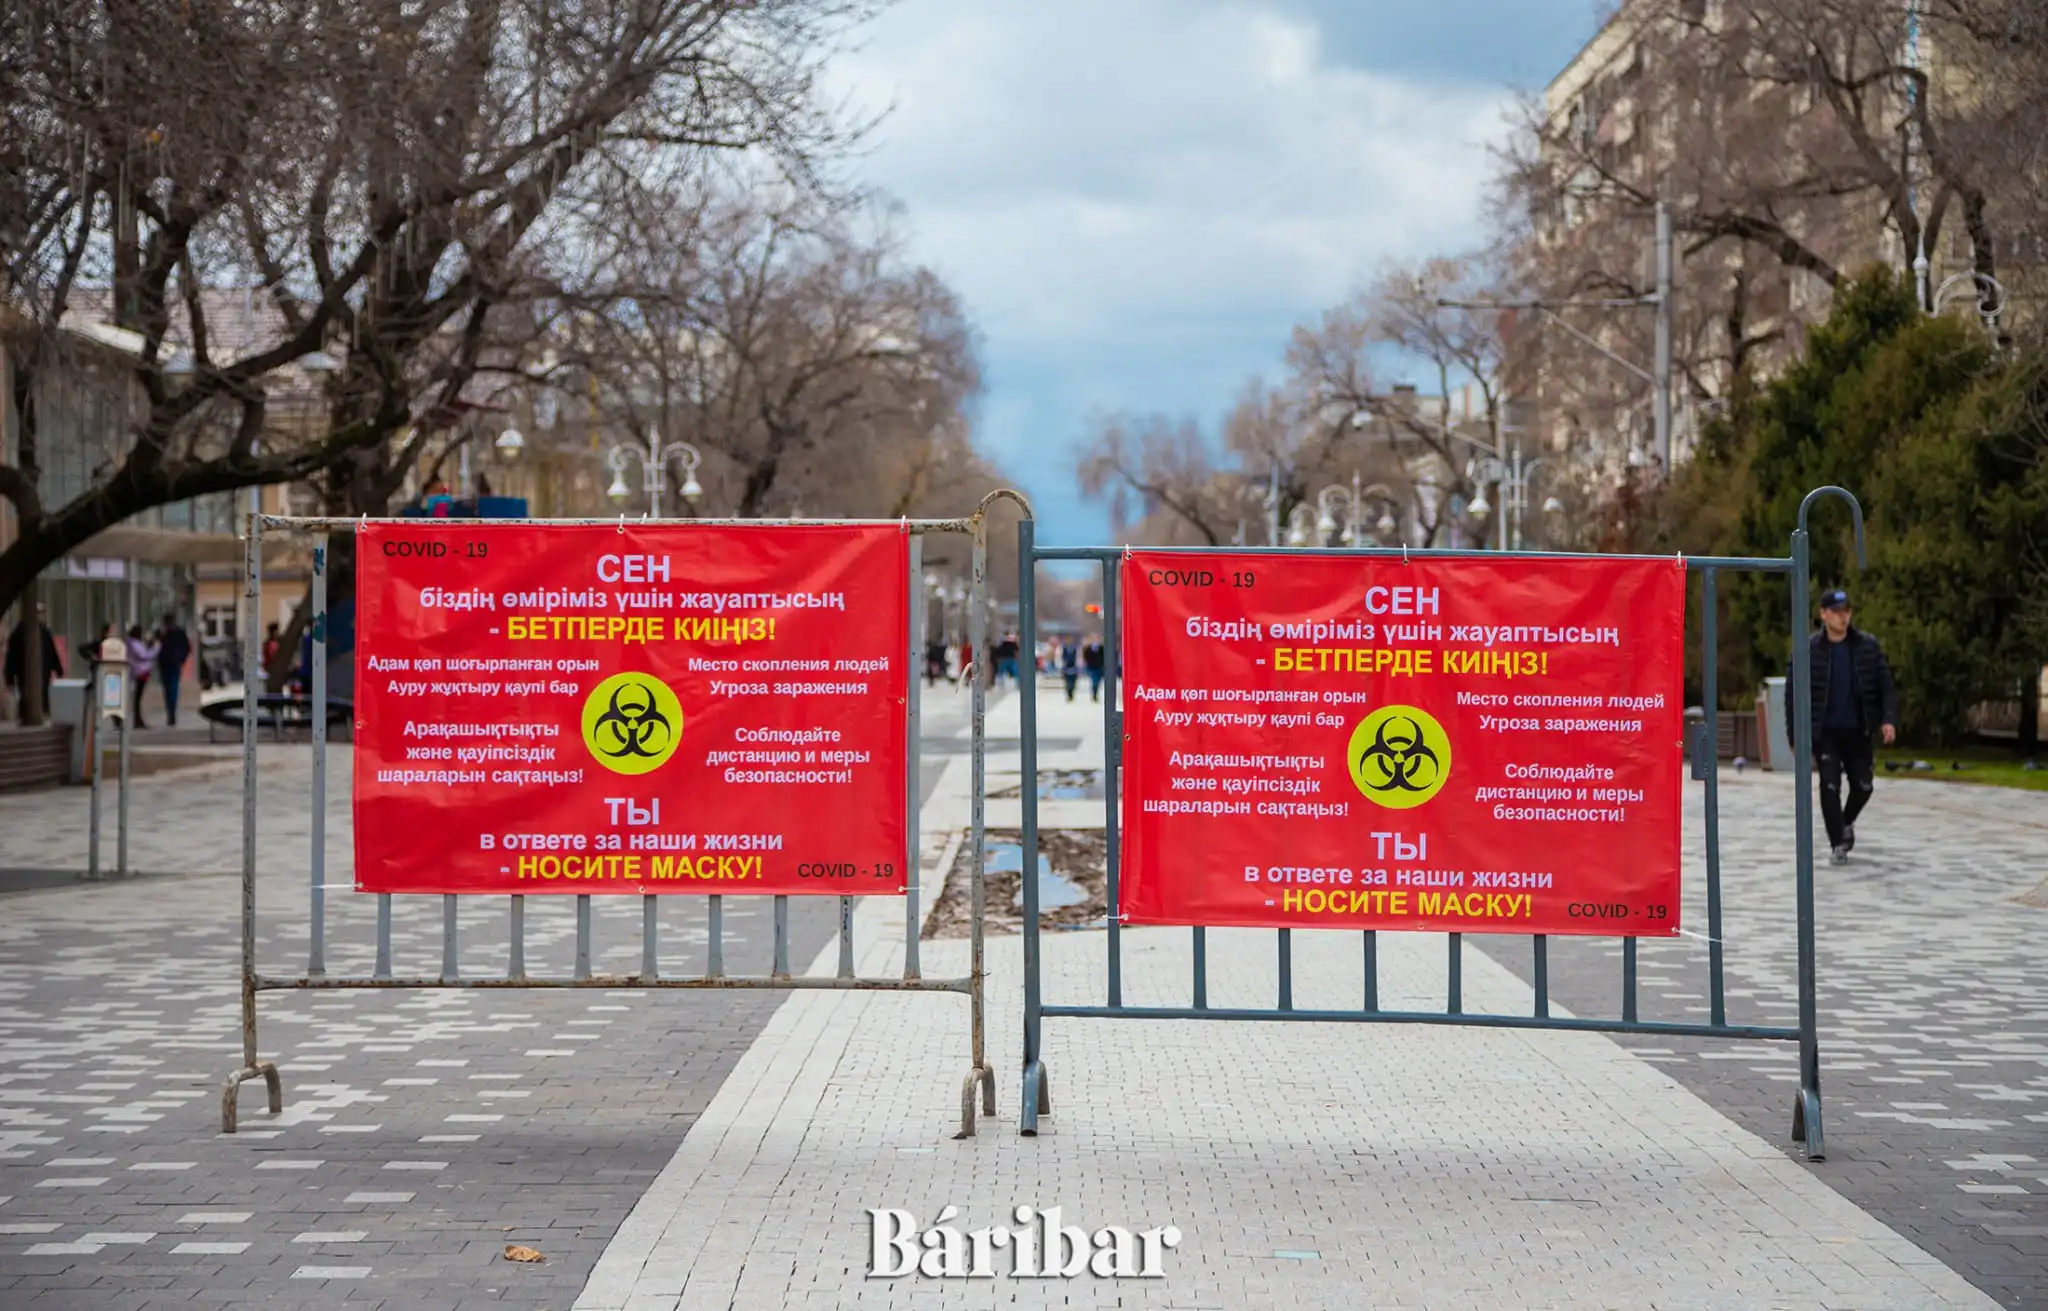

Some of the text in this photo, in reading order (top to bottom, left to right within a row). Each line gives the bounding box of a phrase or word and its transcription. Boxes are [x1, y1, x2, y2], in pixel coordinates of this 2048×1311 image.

[382, 540, 447, 558] COVID
[466, 541, 489, 558] 19
[596, 554, 670, 583] СЕН
[1148, 570, 1214, 587] COVID
[1233, 571, 1255, 588] 19
[419, 586, 845, 614] біздің өміріміз үшін жауаптысың
[1365, 586, 1440, 616] СЕН
[508, 616, 664, 645] БЕТПЕРДЕ
[674, 617, 776, 645] КИІҢІЗ!
[1186, 616, 1619, 648] біздің өміріміз үшін жауаптысың
[367, 655, 410, 672] Адам
[446, 659, 553, 674] шоғырланған
[556, 659, 599, 674] орын
[688, 656, 889, 674] Место скопления людей
[1274, 647, 1433, 678] БЕТПЕРДЕ
[1443, 650, 1548, 679] КИІҢІЗ!
[387, 680, 579, 697] Ауру жұқтыру қаупі бар
[710, 680, 868, 698] Угроза заражения
[1134, 684, 1177, 702] Адам
[1212, 689, 1319, 705] шоғырланған
[1323, 691, 1366, 706] орын
[1457, 691, 1664, 711] Место скопления людей
[1153, 709, 1345, 729] Ауру жұқтыру қаупі бар
[1479, 714, 1642, 734] Угроза заражения
[403, 720, 559, 740] Арақашықтықты
[735, 726, 841, 746] Соблюдайте
[406, 744, 556, 764] және қауіпсіздік
[706, 750, 870, 767] дистанцию и меры
[1169, 750, 1325, 772] Арақашықтықты
[377, 769, 583, 787] шараларын сақтаңыз!
[724, 767, 852, 784] безопасности!
[1505, 763, 1614, 783] Соблюдайте
[1171, 775, 1321, 796] және қауіпсіздік
[1475, 787, 1644, 805] дистанцию и меры
[603, 797, 660, 826] ТЫ
[1143, 799, 1348, 820] шараларын сақтаңыз!
[1493, 803, 1625, 822] безопасности!
[480, 833, 783, 850] в ответе за наши жизни
[1370, 831, 1427, 861] ТЫ
[518, 855, 642, 879] НОСИТЕ
[651, 855, 762, 879] МАСКУ!
[797, 862, 857, 878] COVID
[874, 863, 894, 878] 19
[1244, 866, 1553, 889] в ответе за наши жизни
[1283, 888, 1408, 915] НОСИТЕ
[1418, 891, 1532, 918] МАСКУ!
[1567, 902, 1630, 919] COVID
[1646, 903, 1668, 920] 19
